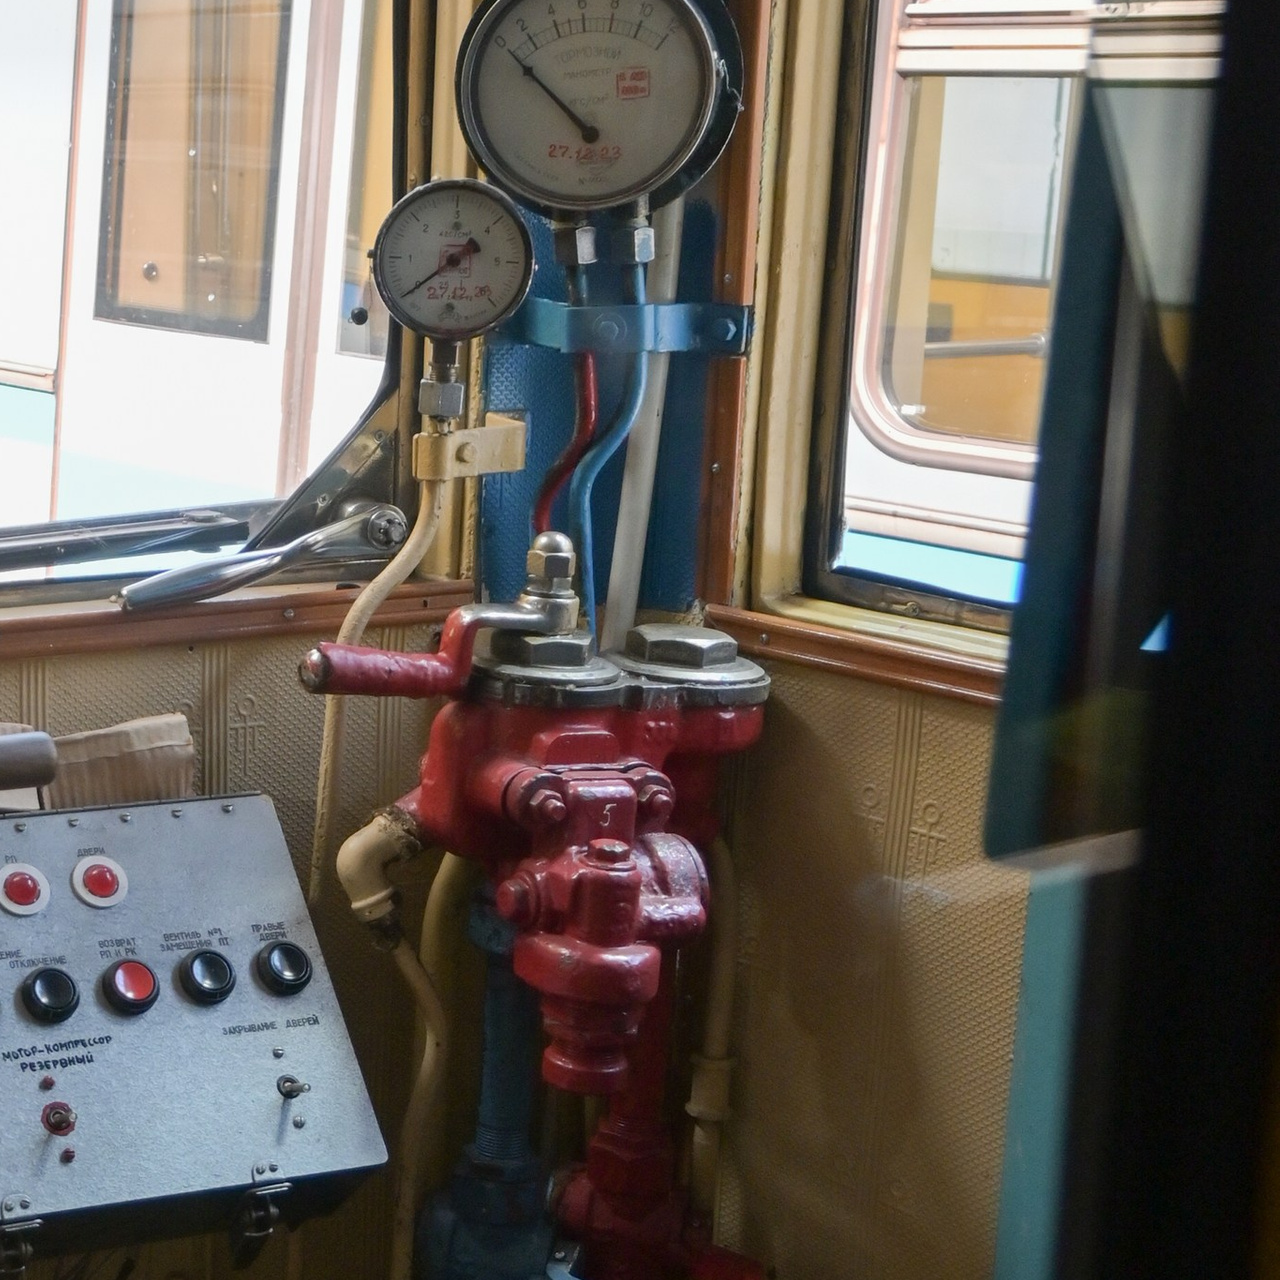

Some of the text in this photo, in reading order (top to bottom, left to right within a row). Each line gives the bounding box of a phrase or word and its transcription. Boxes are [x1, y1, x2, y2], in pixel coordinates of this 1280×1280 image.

[547, 4, 557, 16] 4
[639, 3, 654, 18] 10
[515, 19, 528, 32] 2
[493, 36, 507, 49] 0
[454, 210, 461, 219] 3
[422, 224, 430, 233] 2
[484, 226, 491, 235] 4
[77, 846, 106, 858] ДВЕРИ
[251, 921, 286, 933] ПРАВЫЕ
[163, 930, 201, 942] ВЕНТИЛЬ
[259, 931, 287, 942] ДВЕРИ
[98, 937, 137, 949] ВОЗВРАТ
[160, 939, 213, 952] ЗАМЕЩЕНИЯ
[100, 950, 112, 959] РП
[125, 947, 137, 956] РК
[8, 955, 67, 969] ОТКЛЮЧЕНИЕ
[222, 1014, 320, 1035] ЗАКРЫВАНИЕ ДВЕРЕЙ
[1, 1035, 113, 1062] МОТОР-КОМПРЕССОР
[20, 1051, 95, 1073] РЕЗЕРВНЫЙ
